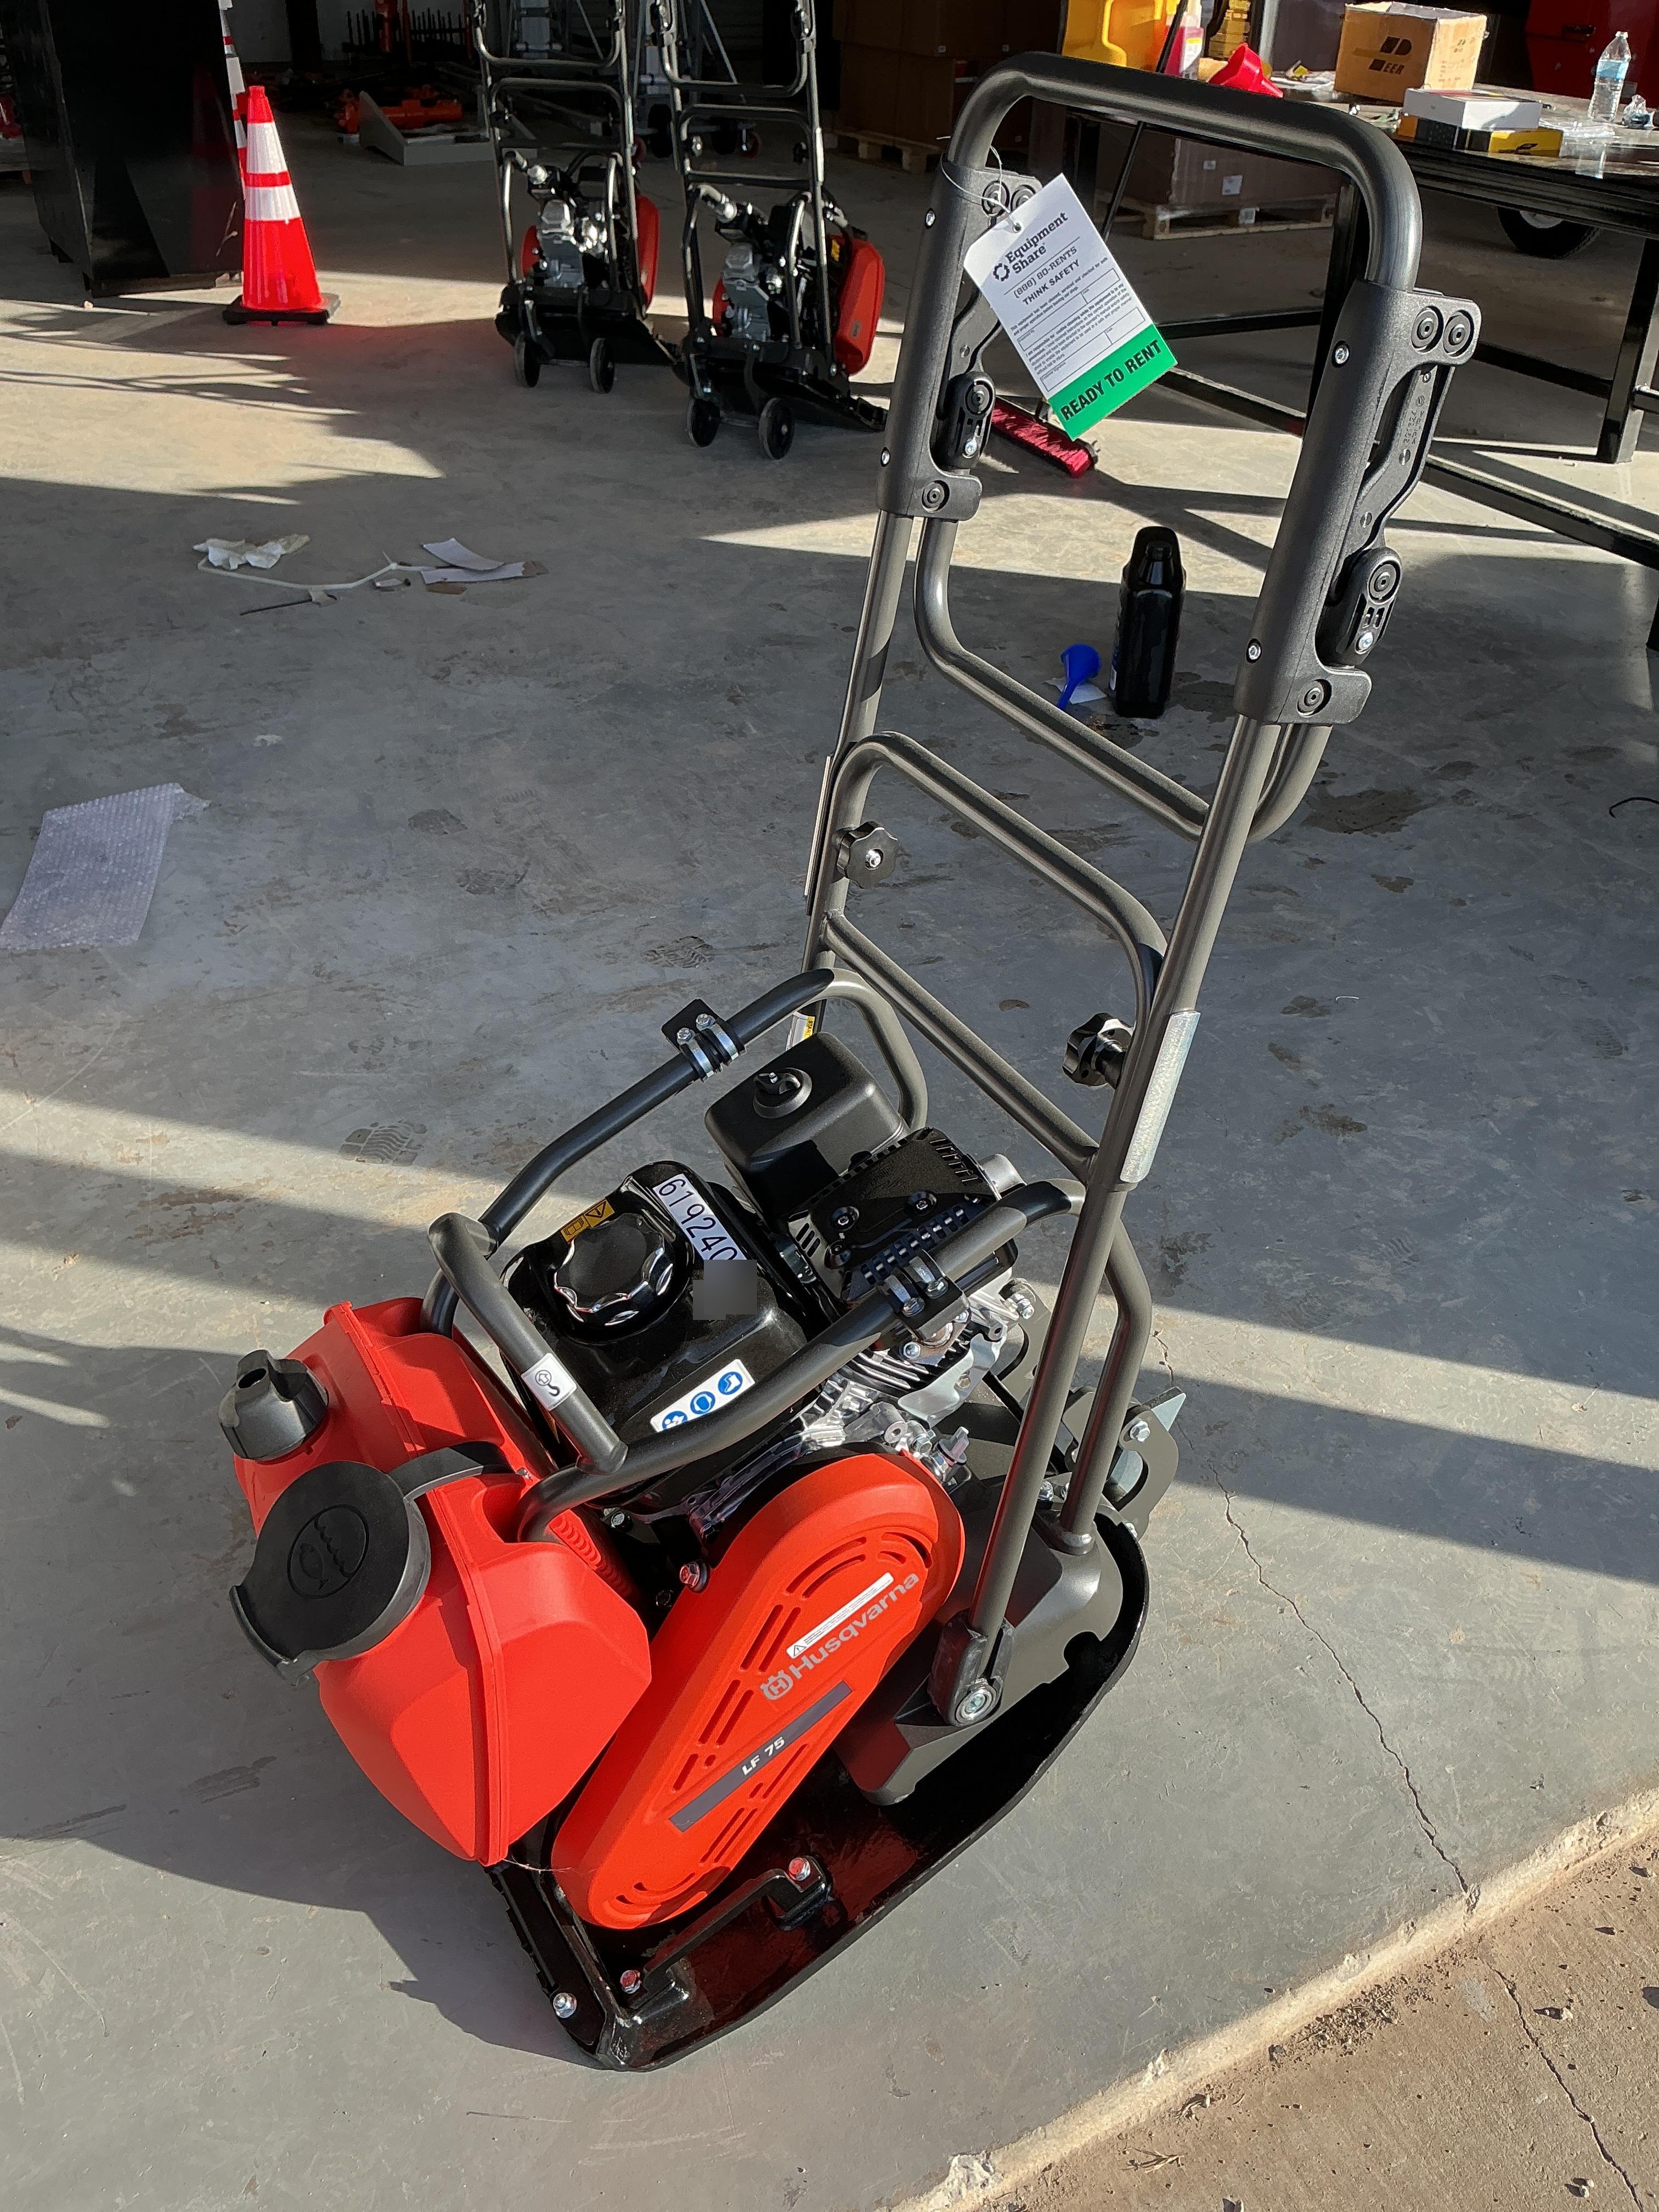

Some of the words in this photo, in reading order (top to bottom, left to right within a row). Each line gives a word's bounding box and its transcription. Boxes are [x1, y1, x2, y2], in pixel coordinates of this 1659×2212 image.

[1005, 212, 1069, 264] Equipment
[1012, 245, 1047, 274] Share
[1013, 277, 1037, 298] (888)
[1036, 246, 1077, 280] 80-RENTS
[1022, 283, 1049, 305] THINK
[1049, 258, 1080, 286] SAFETY
[1060, 380, 1105, 421] READY
[1103, 368, 1125, 387] TO
[1124, 339, 1162, 374] RENT
[789, 1573, 918, 1679] Husqvarna
[742, 1754, 761, 1776] LF
[764, 1735, 786, 1756] 75
